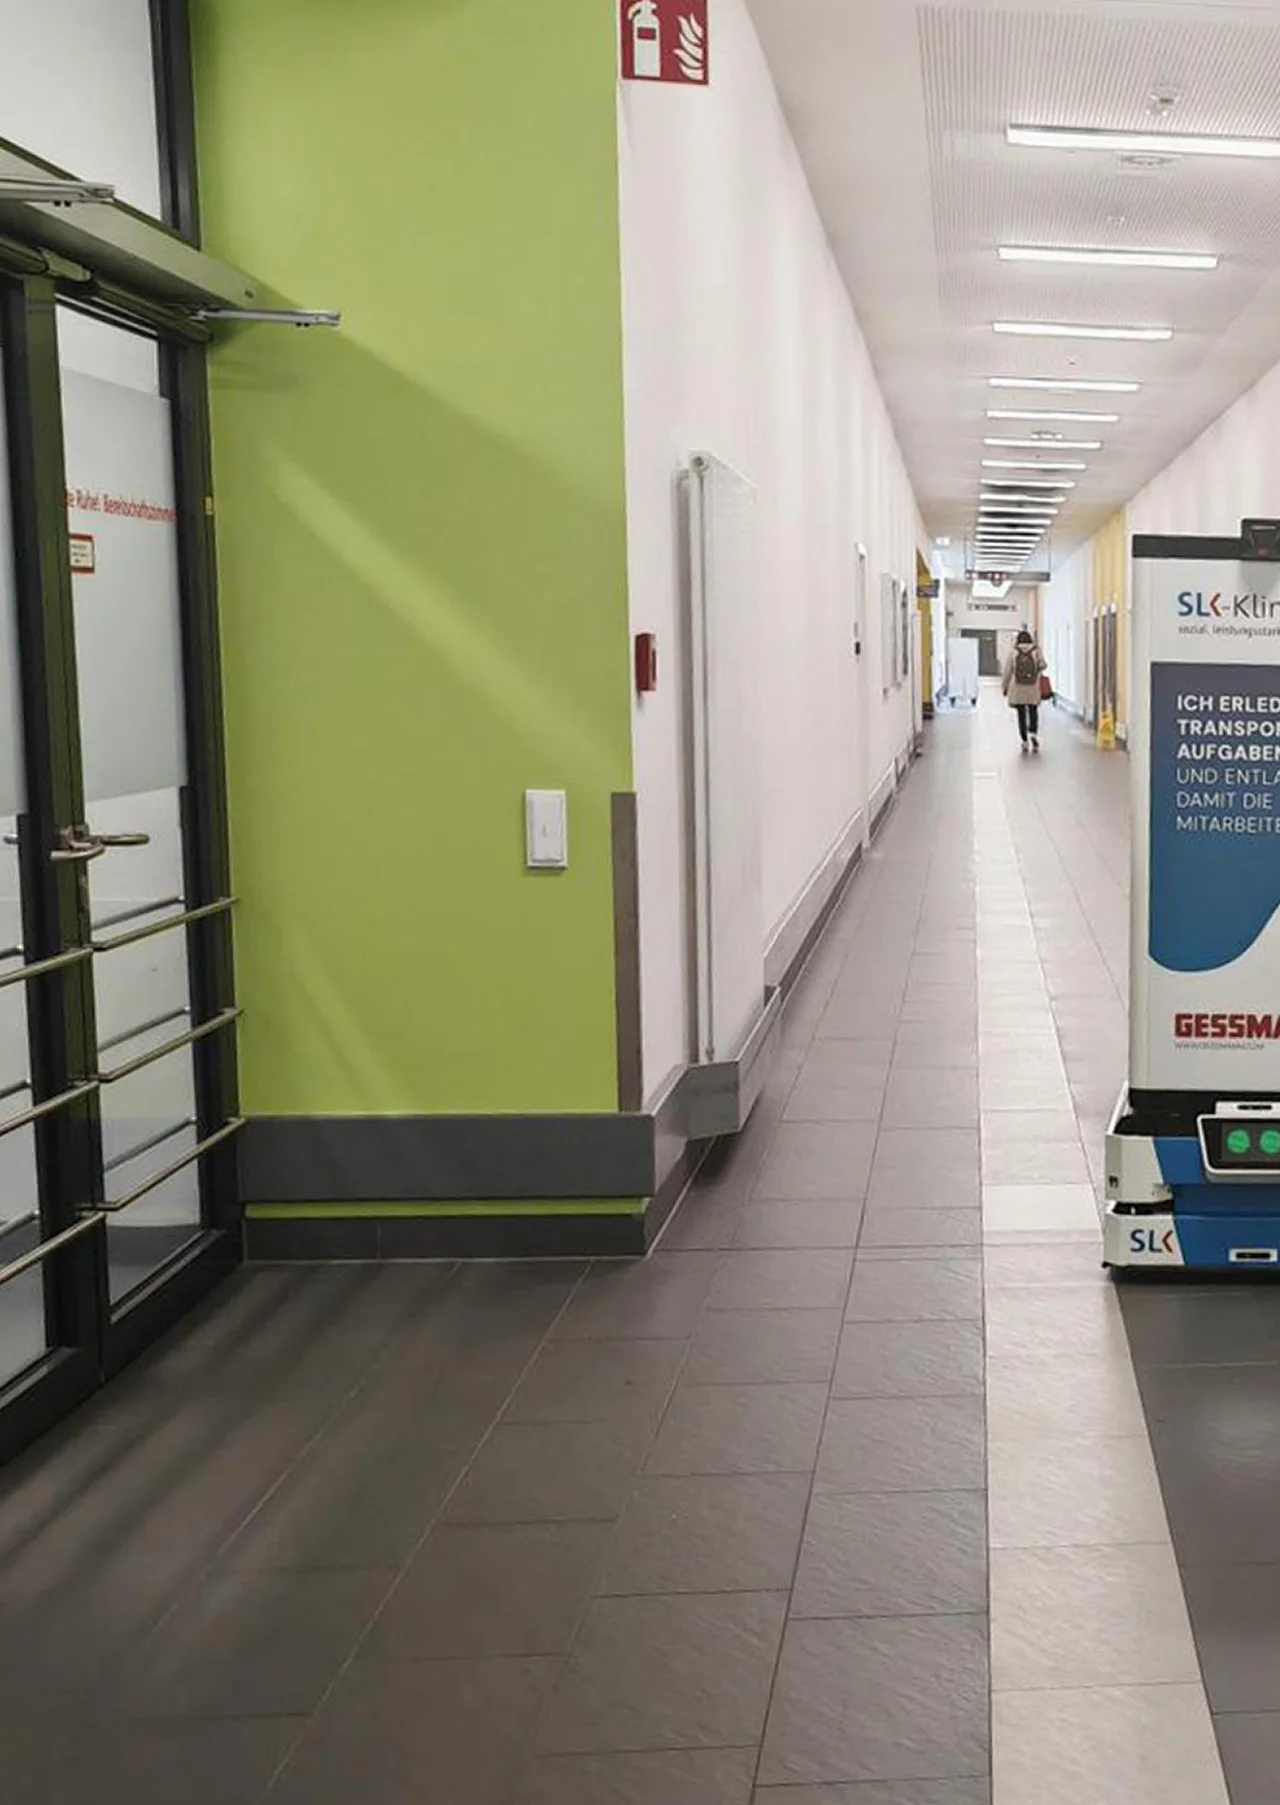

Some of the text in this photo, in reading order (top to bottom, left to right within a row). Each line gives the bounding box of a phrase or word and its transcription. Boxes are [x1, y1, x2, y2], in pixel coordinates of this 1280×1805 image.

[1177, 694, 1213, 712] ICH
[1176, 768, 1218, 785] UND
[1176, 791, 1273, 809] DAMIT DIE
[1130, 1229, 1174, 1253] SLK
